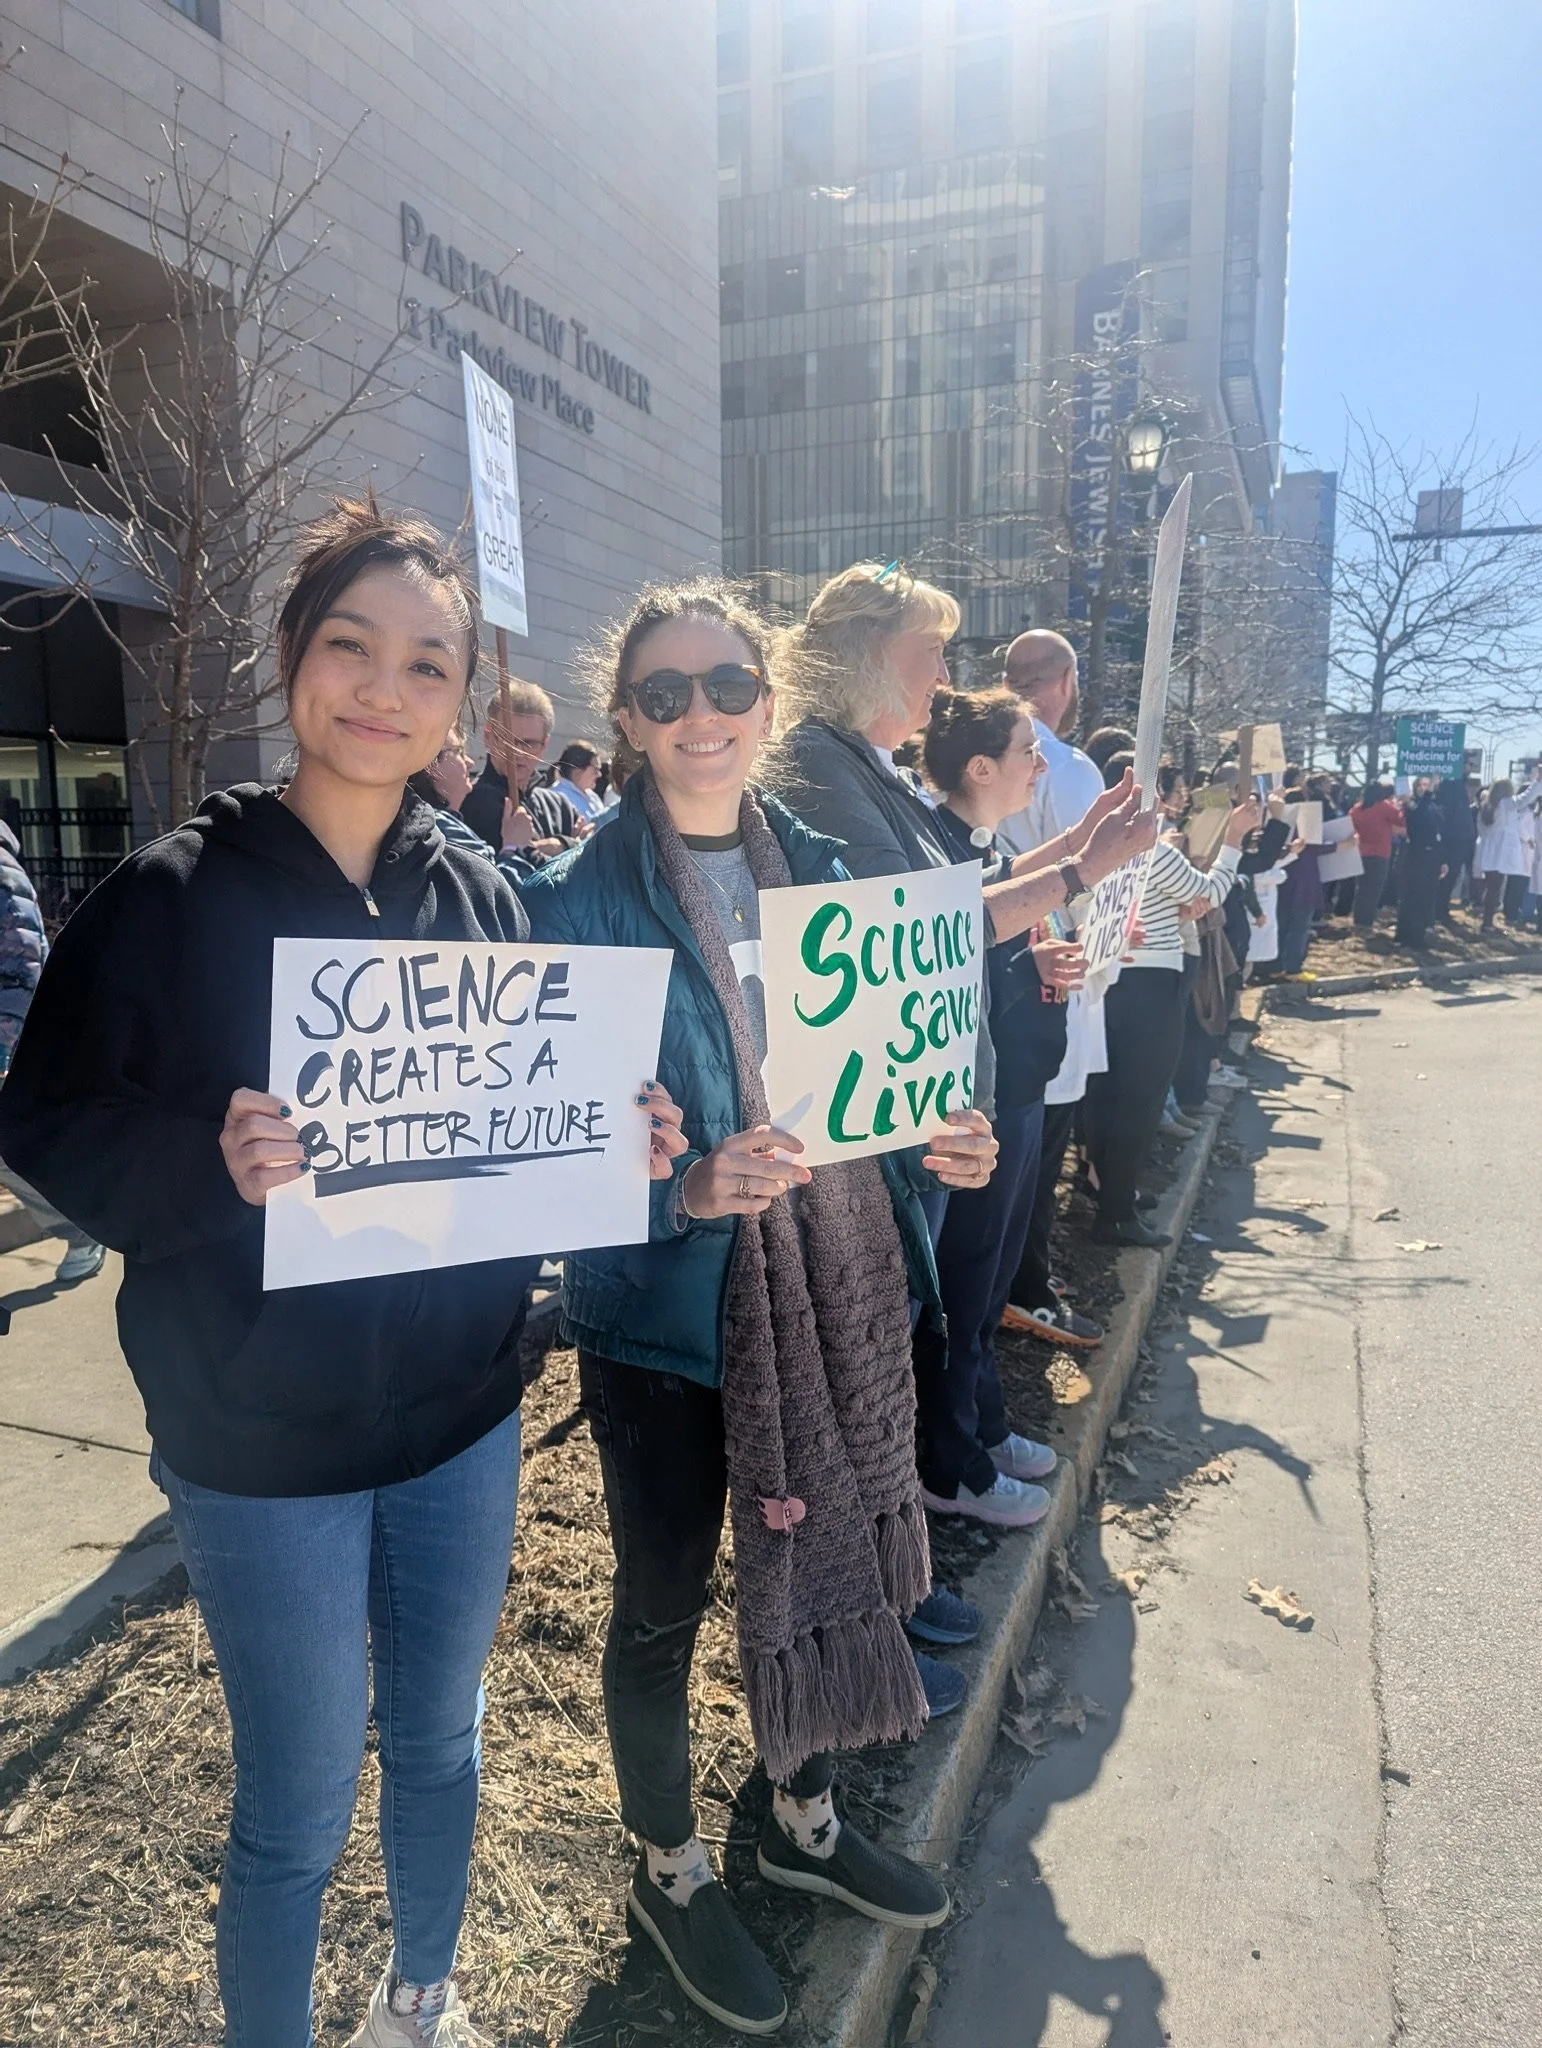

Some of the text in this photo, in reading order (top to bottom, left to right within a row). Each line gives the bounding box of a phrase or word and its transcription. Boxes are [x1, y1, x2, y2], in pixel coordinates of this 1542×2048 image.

[474, 392, 509, 446] NONE
[542, 373, 595, 434] Place
[484, 532, 519, 577] GREAT
[1400, 750, 1461, 761] Medicine for
[1410, 721, 1456, 734] SCIENCE
[1410, 736, 1453, 747] The Best
[1404, 761, 1454, 774] Ignorance
[1090, 872, 1134, 926] SAVES
[794, 887, 975, 1028] Science
[295, 952, 577, 1040] SCIENCE
[886, 981, 979, 1064] saves
[296, 1038, 559, 1109] CREATES A
[827, 1049, 973, 1143] Lives
[299, 1099, 611, 1174] BETTER FUTURE
